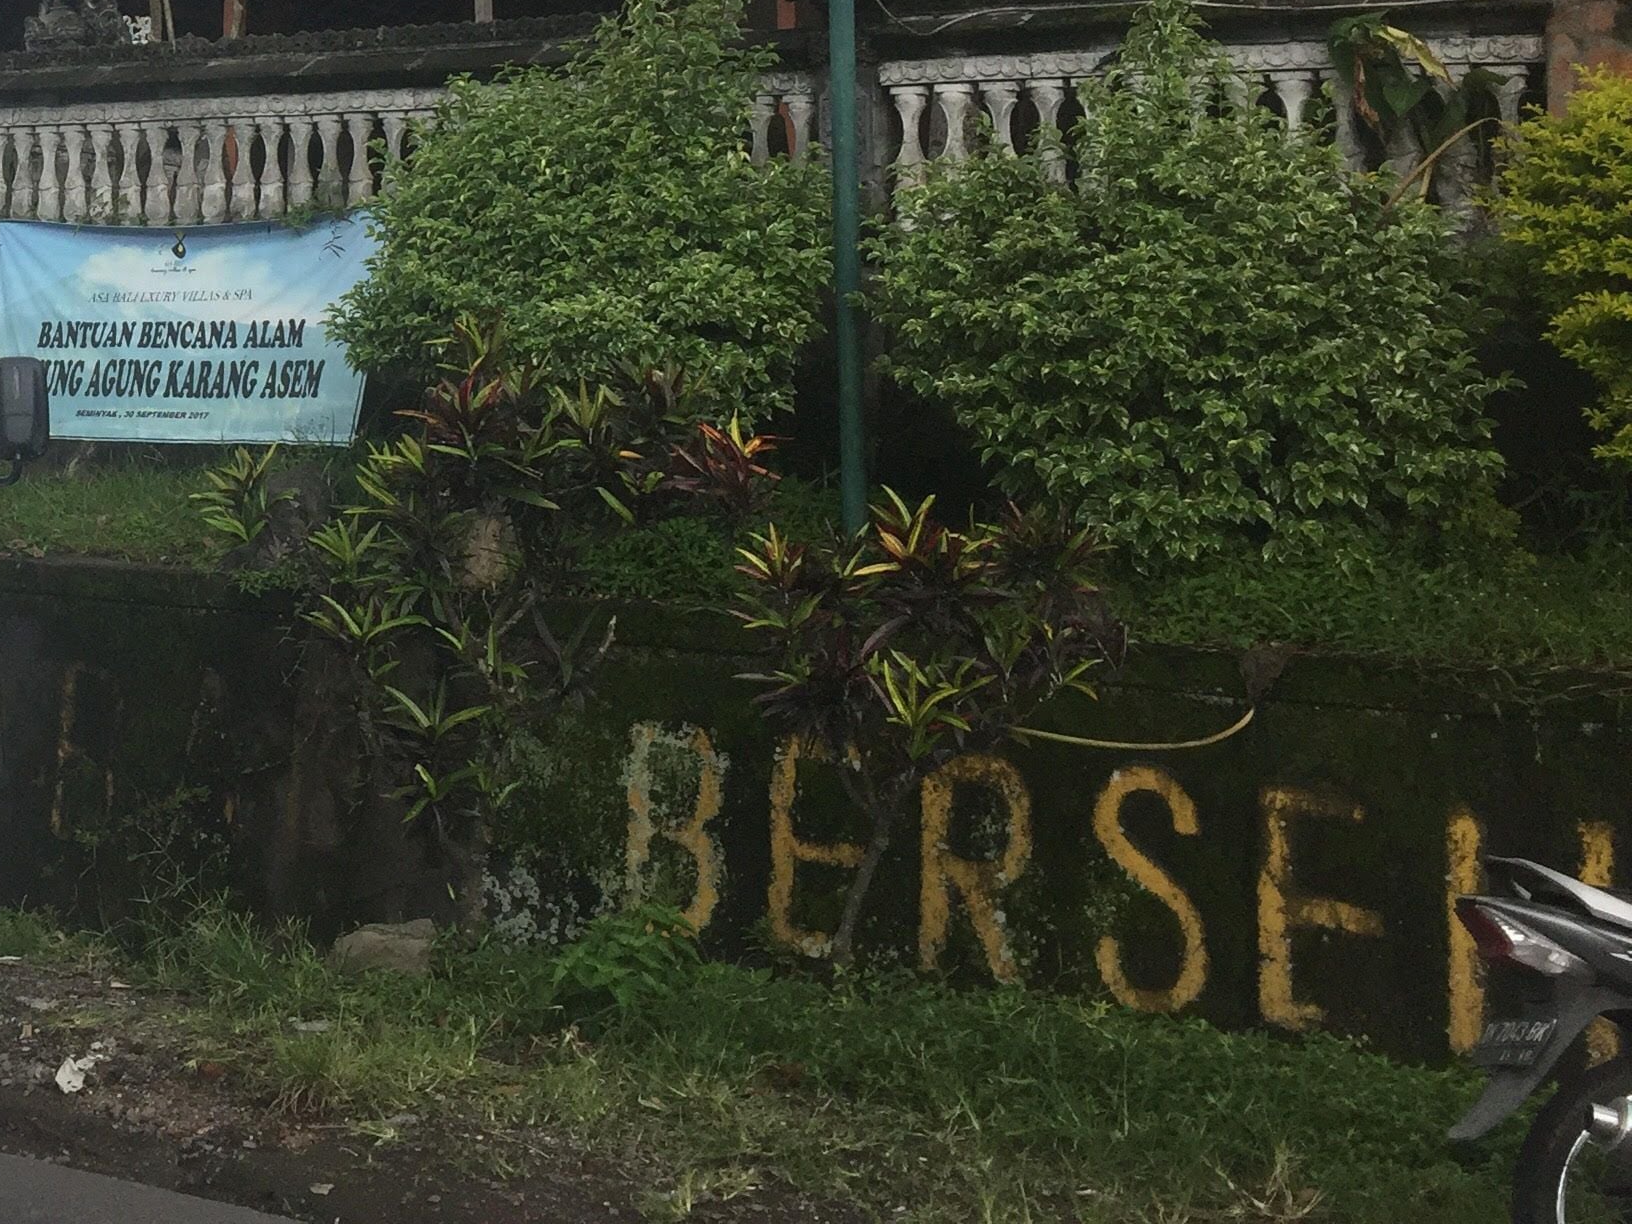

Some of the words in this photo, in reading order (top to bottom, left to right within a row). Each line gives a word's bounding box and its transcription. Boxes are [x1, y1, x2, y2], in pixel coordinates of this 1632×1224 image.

[182, 288, 220, 302] VILLAS
[234, 288, 253, 301] SPA
[37, 321, 137, 349] BANTUAN
[137, 320, 238, 349] BENCANA
[243, 318, 307, 349] ALAM
[85, 359, 160, 398] AGUNG
[162, 359, 259, 399] KARANG
[260, 359, 325, 398] ASEM
[136, 411, 186, 419] SEPTEMBER
[188, 411, 210, 419] 2017
